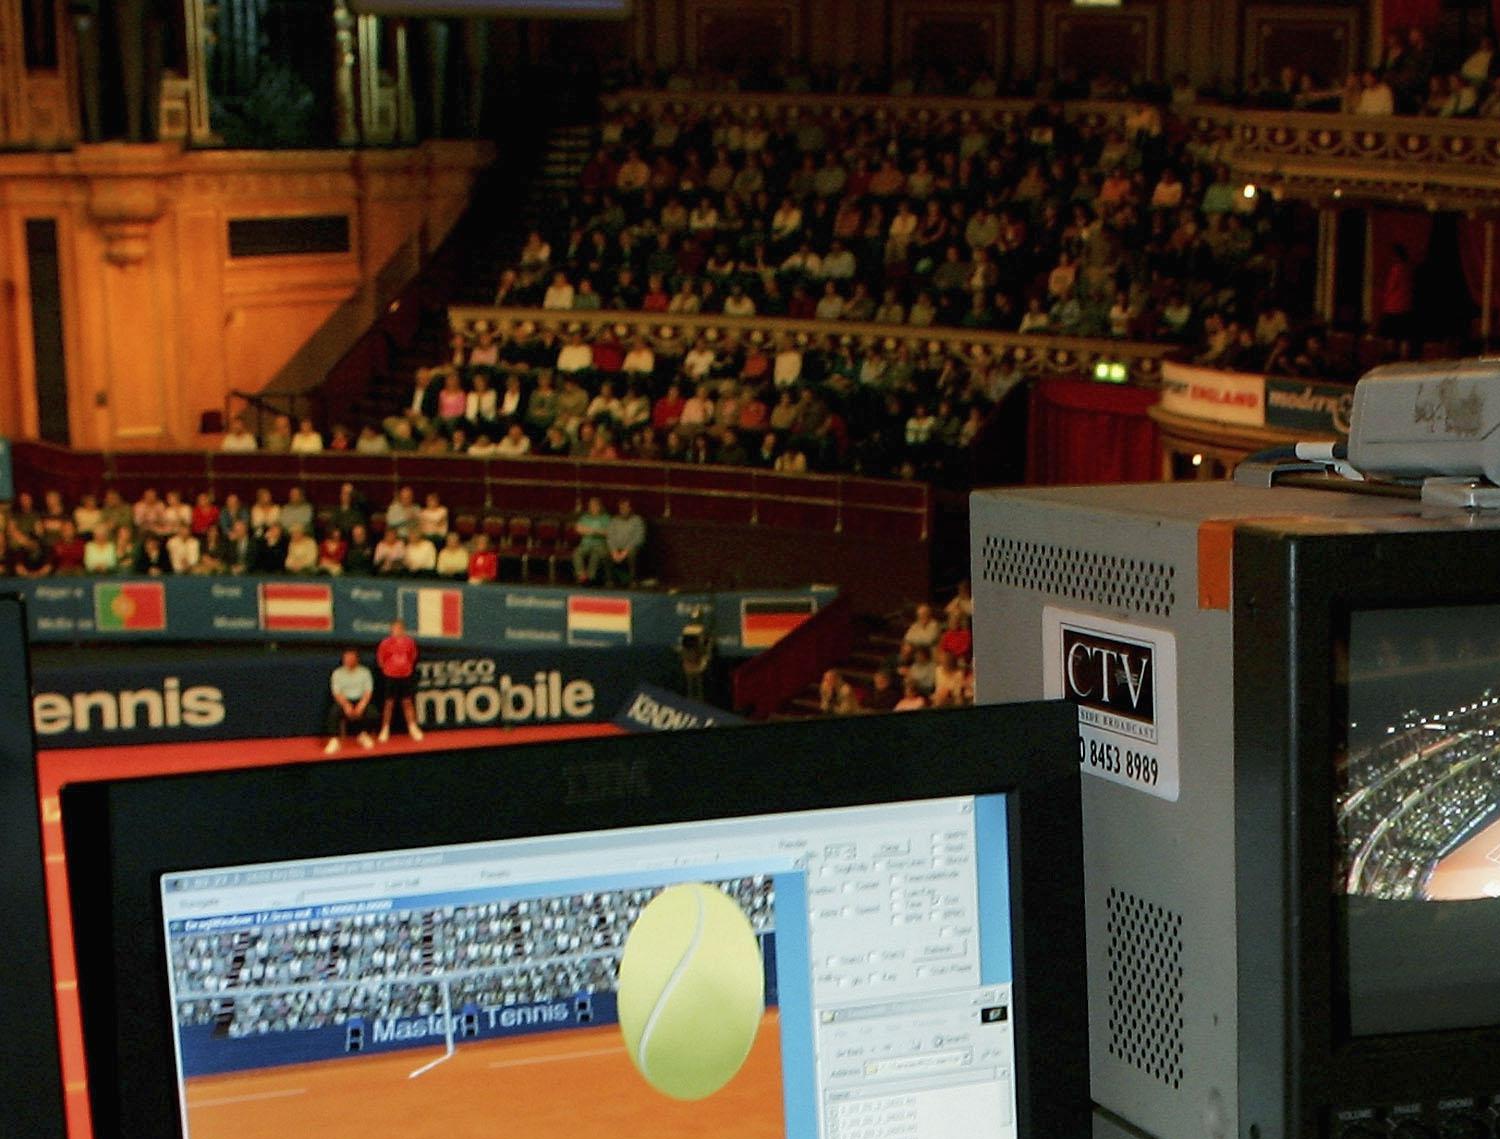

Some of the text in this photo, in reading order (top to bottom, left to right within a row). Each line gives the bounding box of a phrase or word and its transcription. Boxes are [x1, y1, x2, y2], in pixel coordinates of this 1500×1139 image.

[418, 659, 497, 680] TESCO
[1066, 641, 1150, 710] CTV
[33, 676, 226, 735] ennis
[415, 671, 596, 725] mobile
[1102, 714, 1155, 739] BROADCAST
[1090, 740, 1121, 774] 8453
[1126, 750, 1159, 786] 8989
[482, 1001, 570, 1029] Tennis
